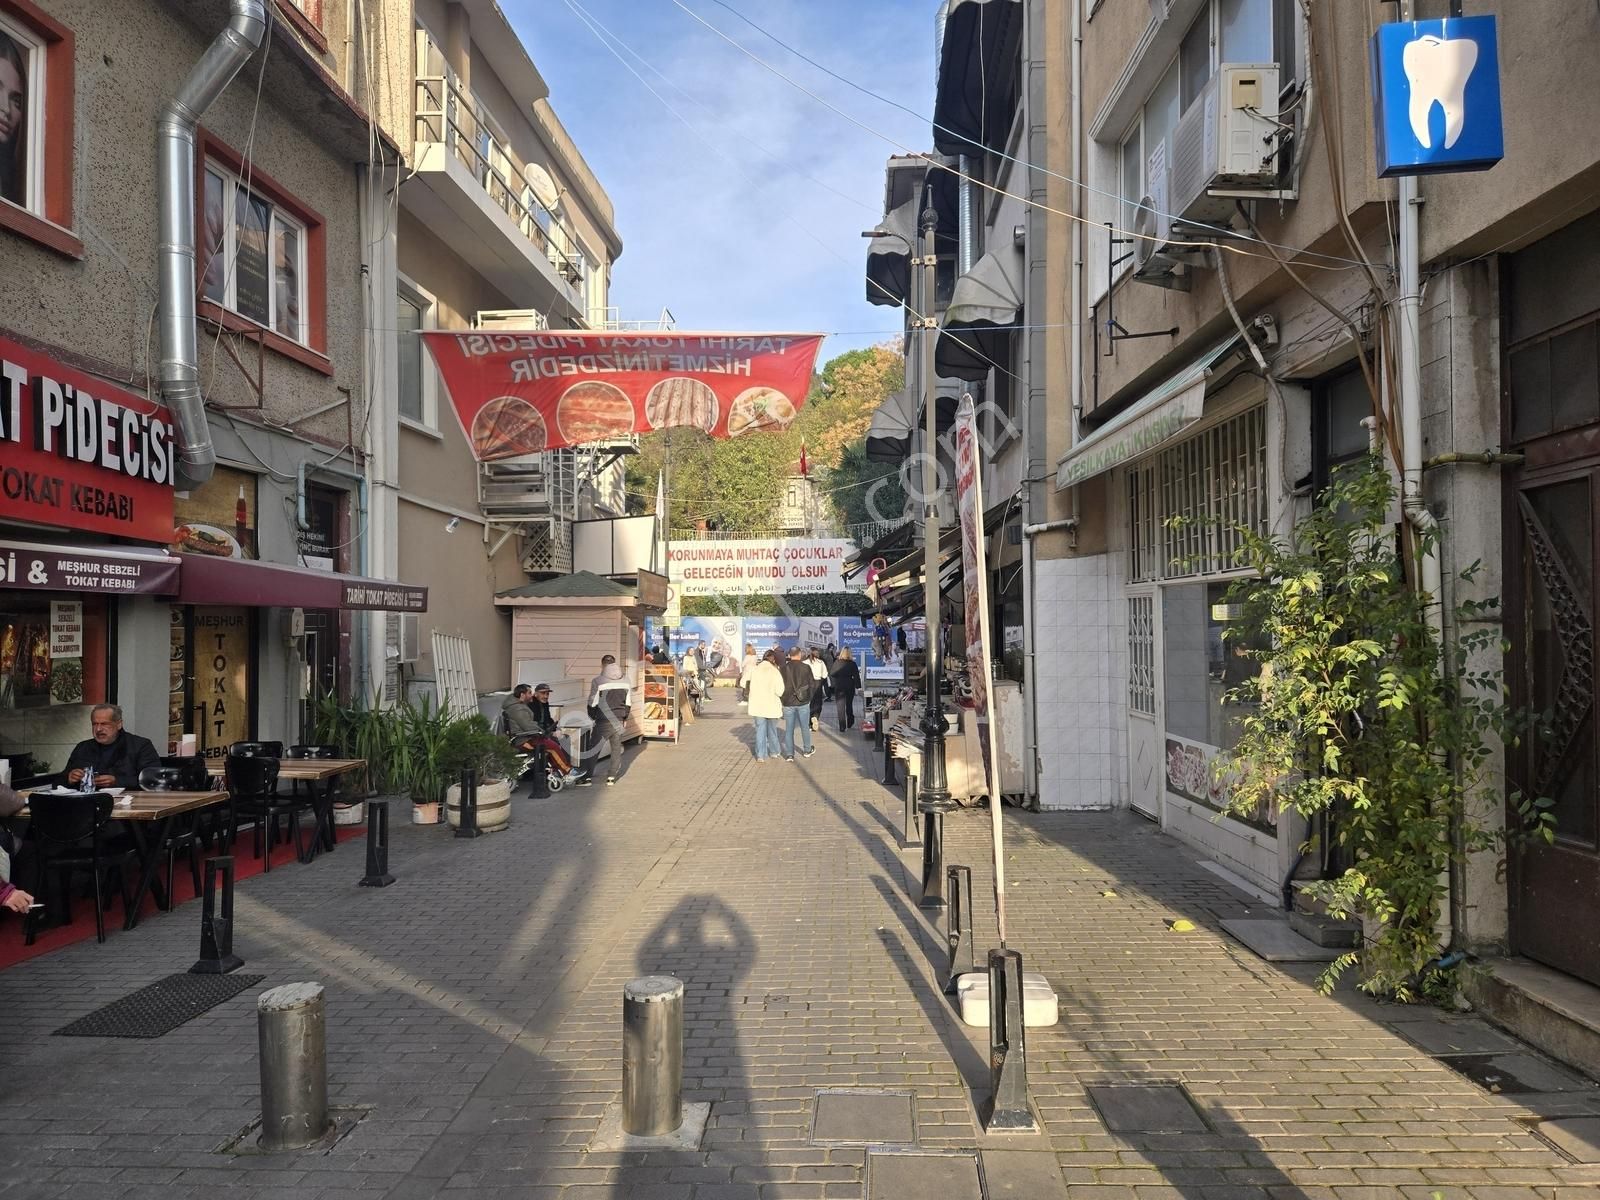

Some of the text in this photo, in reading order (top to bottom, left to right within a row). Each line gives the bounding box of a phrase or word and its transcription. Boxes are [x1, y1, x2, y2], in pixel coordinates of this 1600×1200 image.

[0, 359, 28, 443] T
[70, 482, 134, 522] KEBABI
[668, 546, 843, 563] KORUNMAYA MUHTAÇ ÇOCUKLAR
[27, 560, 49, 585] &
[57, 560, 141, 577] MEŞHUR SEBZELİ
[683, 564, 828, 580] GELECEĞİN UMUDU OLSUN
[65, 575, 136, 590] TOKAT KEBABI
[195, 615, 244, 629] MEŞHUR
